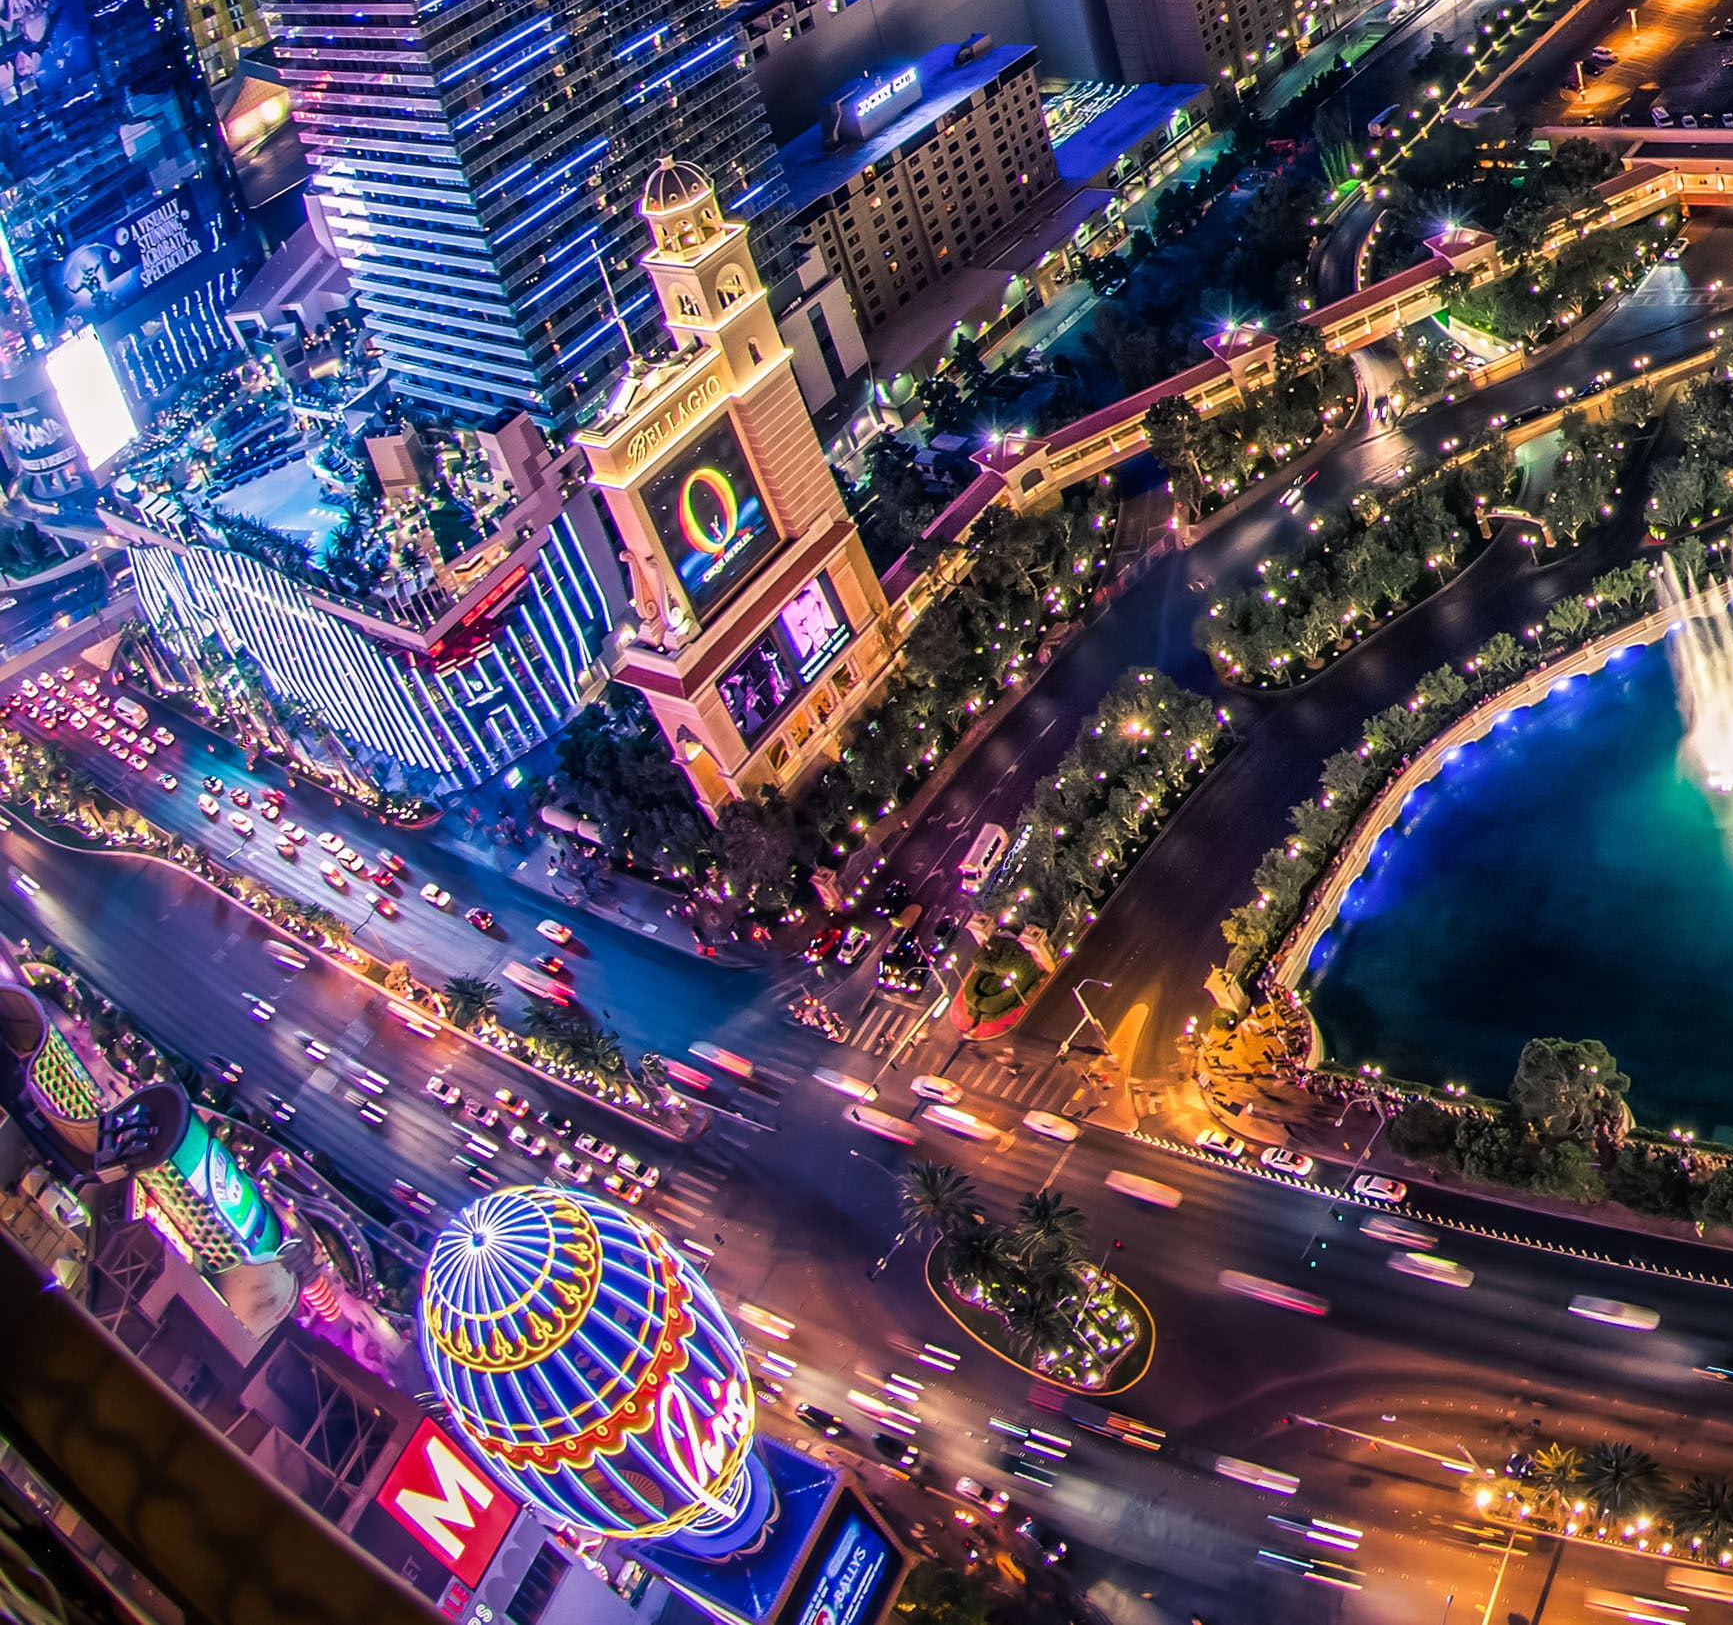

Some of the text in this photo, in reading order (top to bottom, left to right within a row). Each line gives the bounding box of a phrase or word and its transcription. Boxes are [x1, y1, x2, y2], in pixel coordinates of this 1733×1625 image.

[130, 198, 180, 242] A VISUALLY
[137, 215, 183, 254] STUNNING
[139, 239, 202, 288] SPECTACULAR
[140, 227, 191, 271] ACROBATIC
[625, 374, 722, 471] BELLAGIO
[659, 1378, 750, 1520] Paris
[395, 1435, 495, 1560] M
